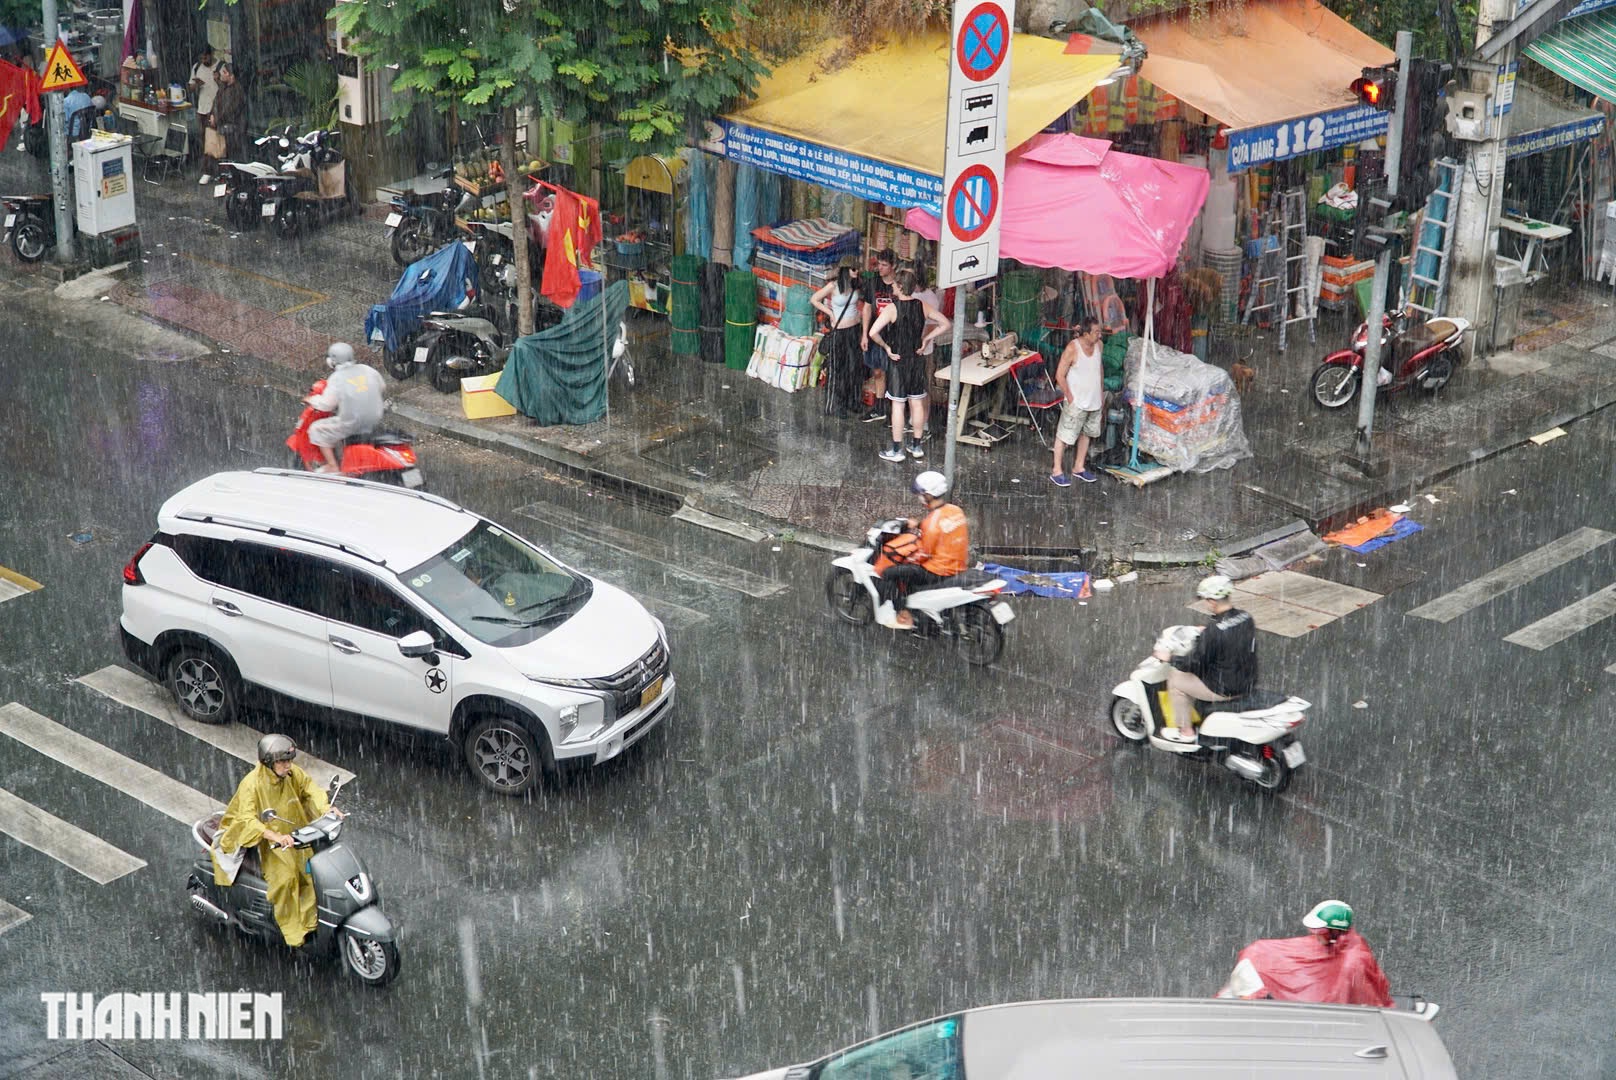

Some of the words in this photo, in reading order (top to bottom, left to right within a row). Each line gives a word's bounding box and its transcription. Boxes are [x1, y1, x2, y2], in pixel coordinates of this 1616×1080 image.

[765, 138, 784, 150] CUNG
[784, 141, 798, 154] CẤP
[850, 160, 859, 171] HỘ
[861, 163, 874, 174] LAO
[1232, 138, 1249, 166] CỬA
[1250, 137, 1274, 162] HÀNG
[1275, 116, 1325, 158] 112
[727, 140, 741, 151] BAO
[780, 153, 800, 167] THANG
[816, 163, 836, 177] THANG
[889, 184, 900, 194] PE,
